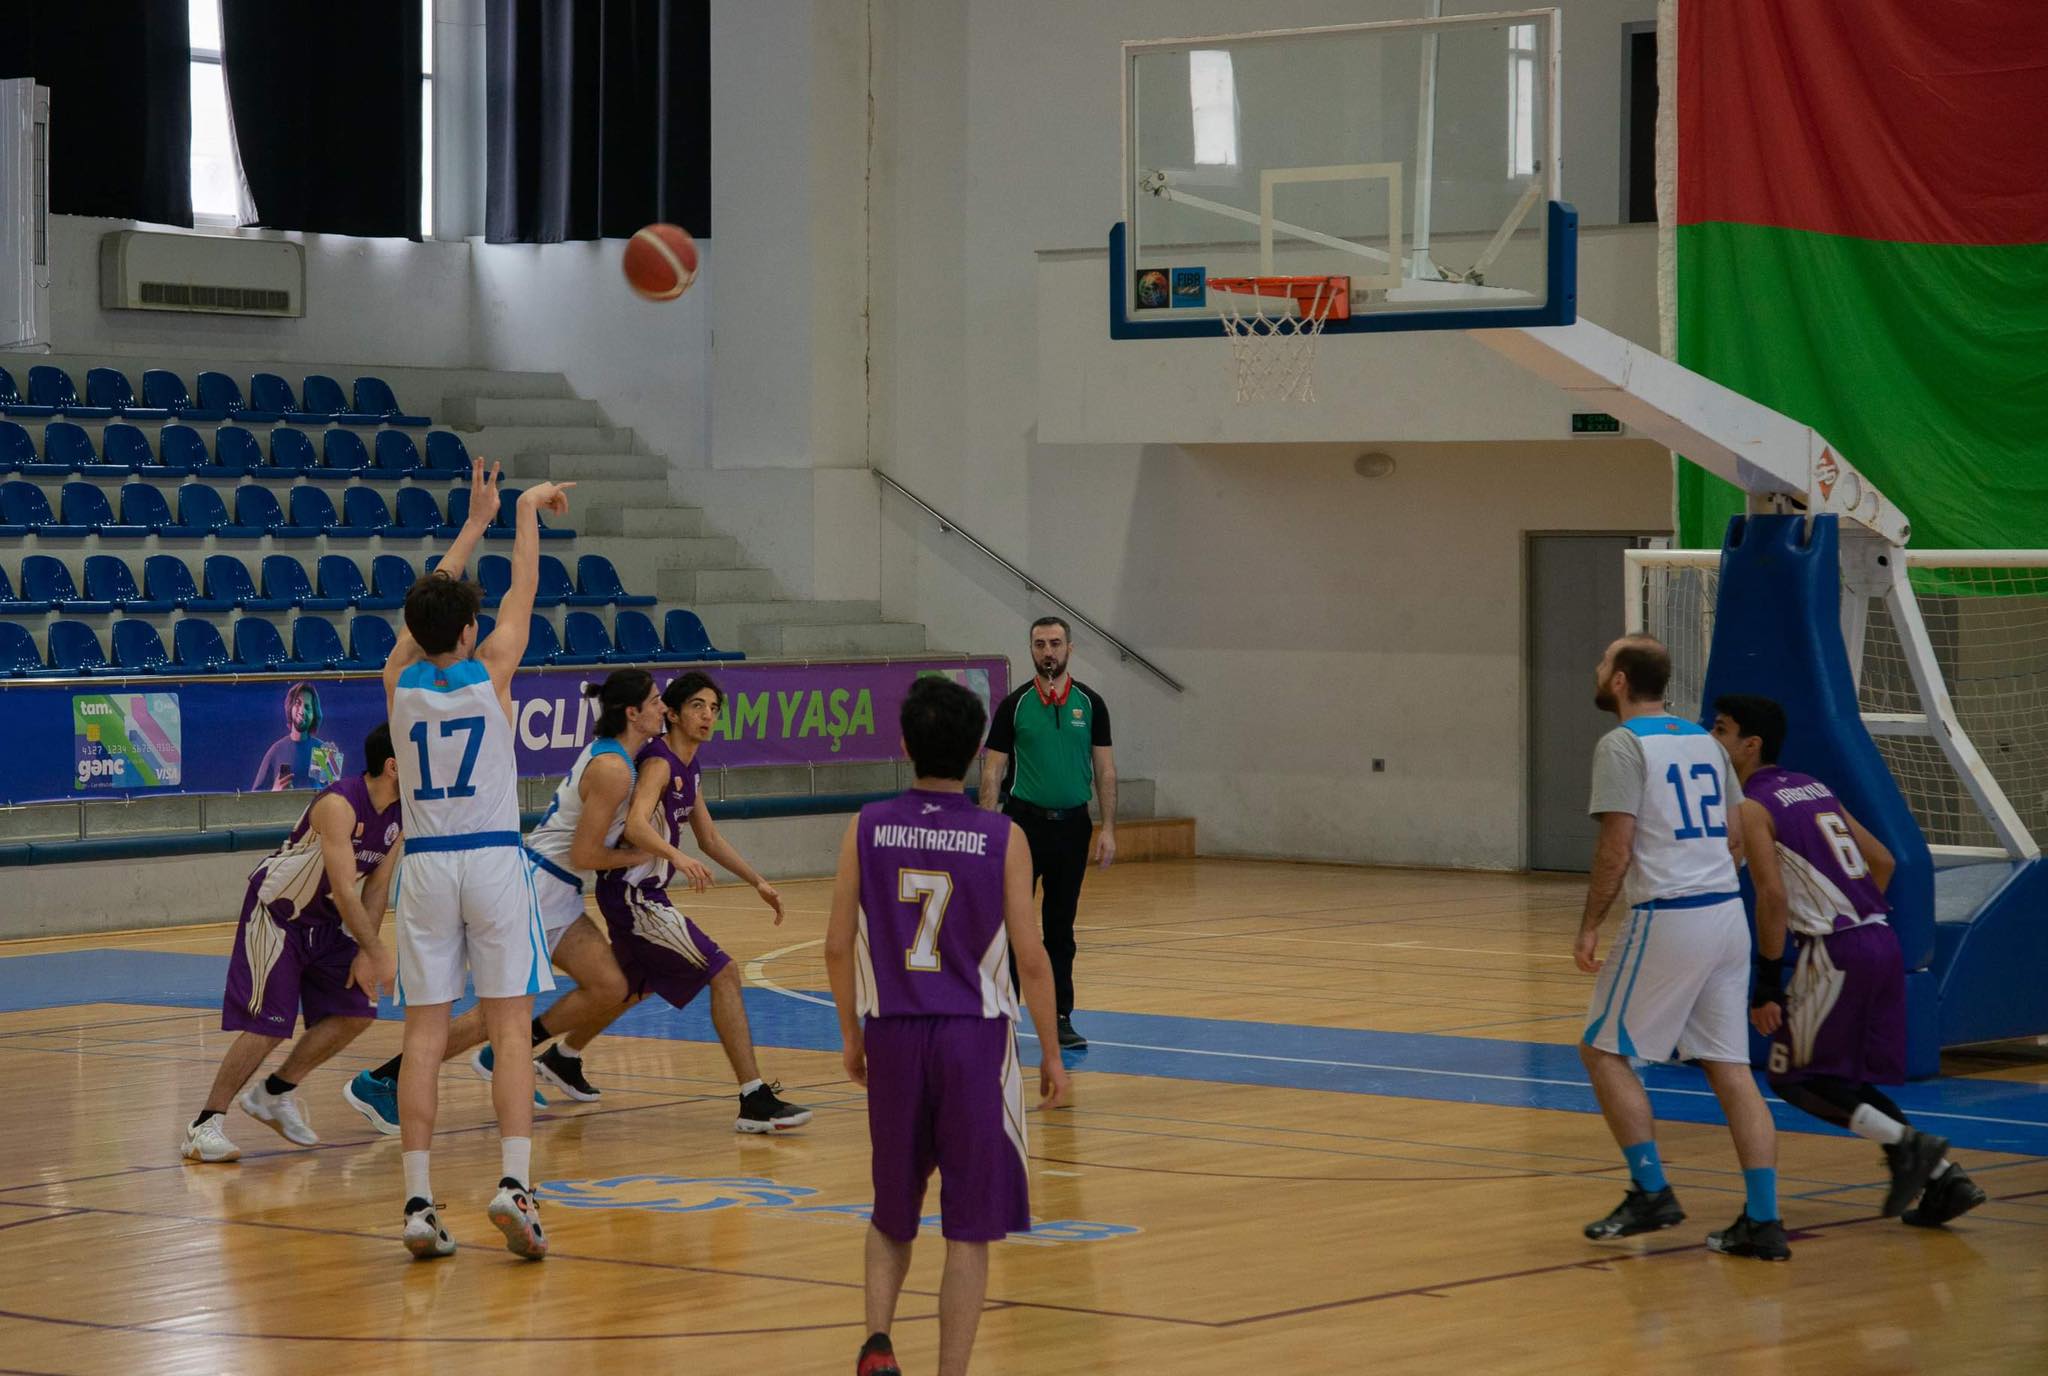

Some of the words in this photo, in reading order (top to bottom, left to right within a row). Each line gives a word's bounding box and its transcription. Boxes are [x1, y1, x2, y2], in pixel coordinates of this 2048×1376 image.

[709, 691, 770, 741] AM
[776, 688, 875, 752] YAŞA
[155, 767, 178, 780] VISA
[409, 716, 486, 801] 17
[1667, 763, 1728, 841] 12
[873, 825, 988, 856] MUKHTARZADE
[1815, 812, 1870, 880] 6
[898, 867, 954, 972] 7
[1768, 1042, 1789, 1075] 6
